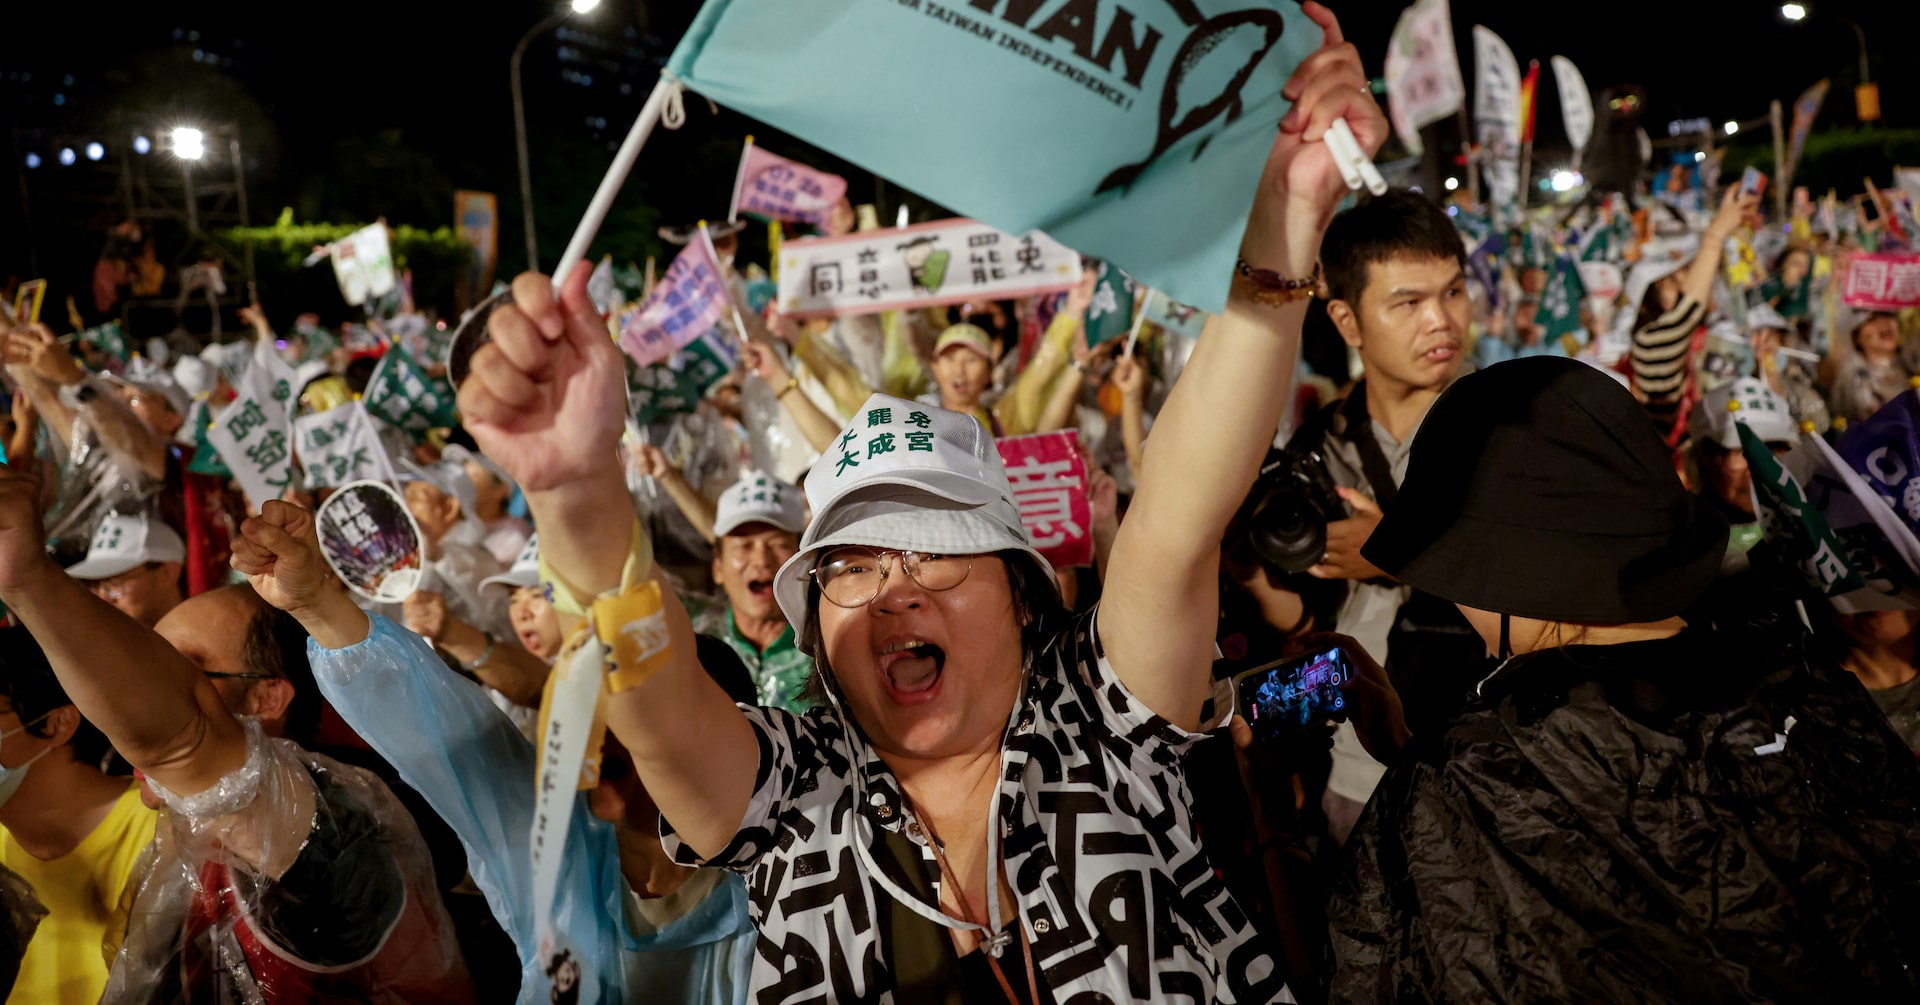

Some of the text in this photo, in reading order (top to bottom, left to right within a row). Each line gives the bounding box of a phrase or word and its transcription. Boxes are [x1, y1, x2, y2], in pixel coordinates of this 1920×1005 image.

[925, 1, 996, 41] TAIWAN
[810, 232, 1045, 299] 同意 罷免
[838, 406, 932, 452] 大罷免
